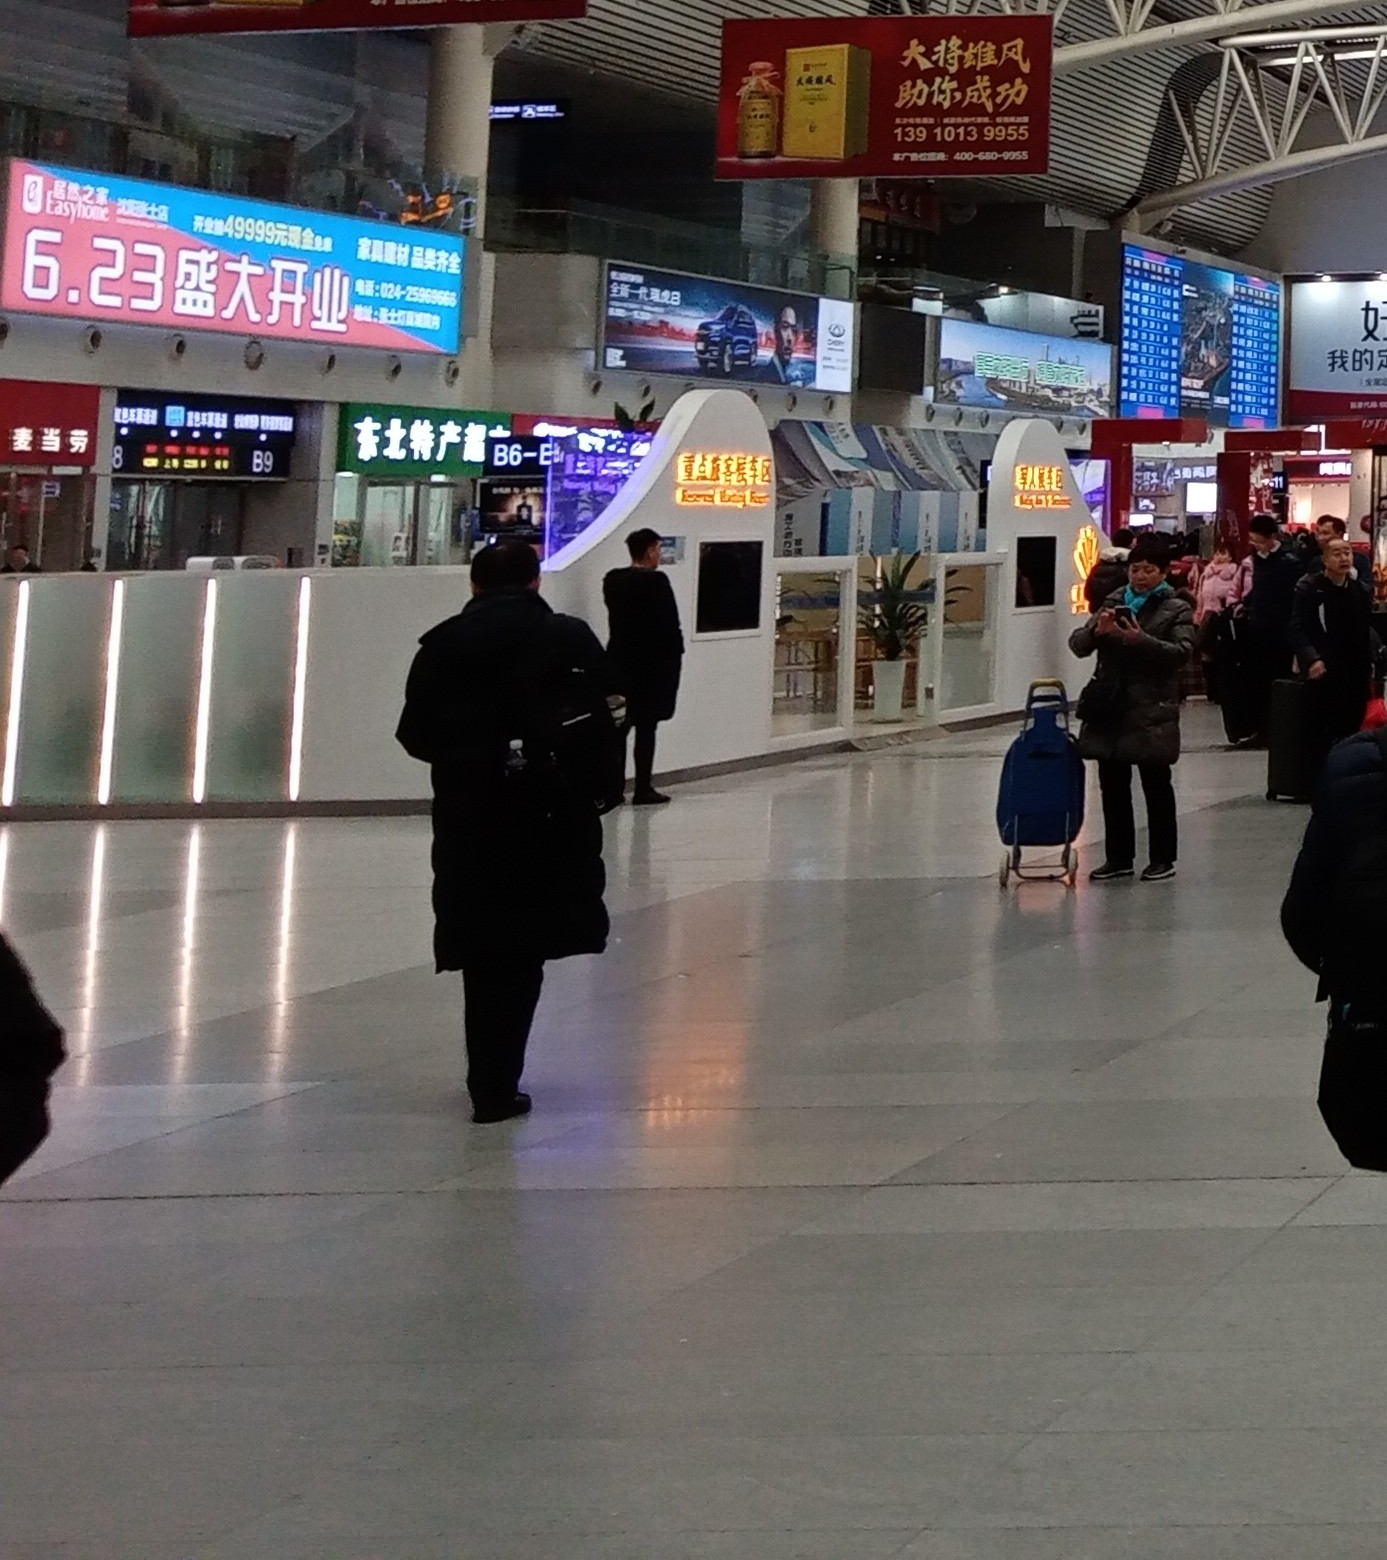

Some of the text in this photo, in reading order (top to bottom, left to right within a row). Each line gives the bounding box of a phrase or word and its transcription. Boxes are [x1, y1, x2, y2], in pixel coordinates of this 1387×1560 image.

[899, 35, 1031, 74] 大将雄风
[894, 75, 1030, 114] 助你成功
[893, 125, 1030, 142] 139 1013 9955
[45, 190, 110, 224] Easyhome
[52, 180, 110, 205] 居然之家
[410, 246, 462, 275] 品类齐全
[11, 426, 90, 454] 麦当劳
[353, 416, 512, 463] 东北特产超
[112, 445, 124, 469] 8
[251, 449, 275, 474] B9
